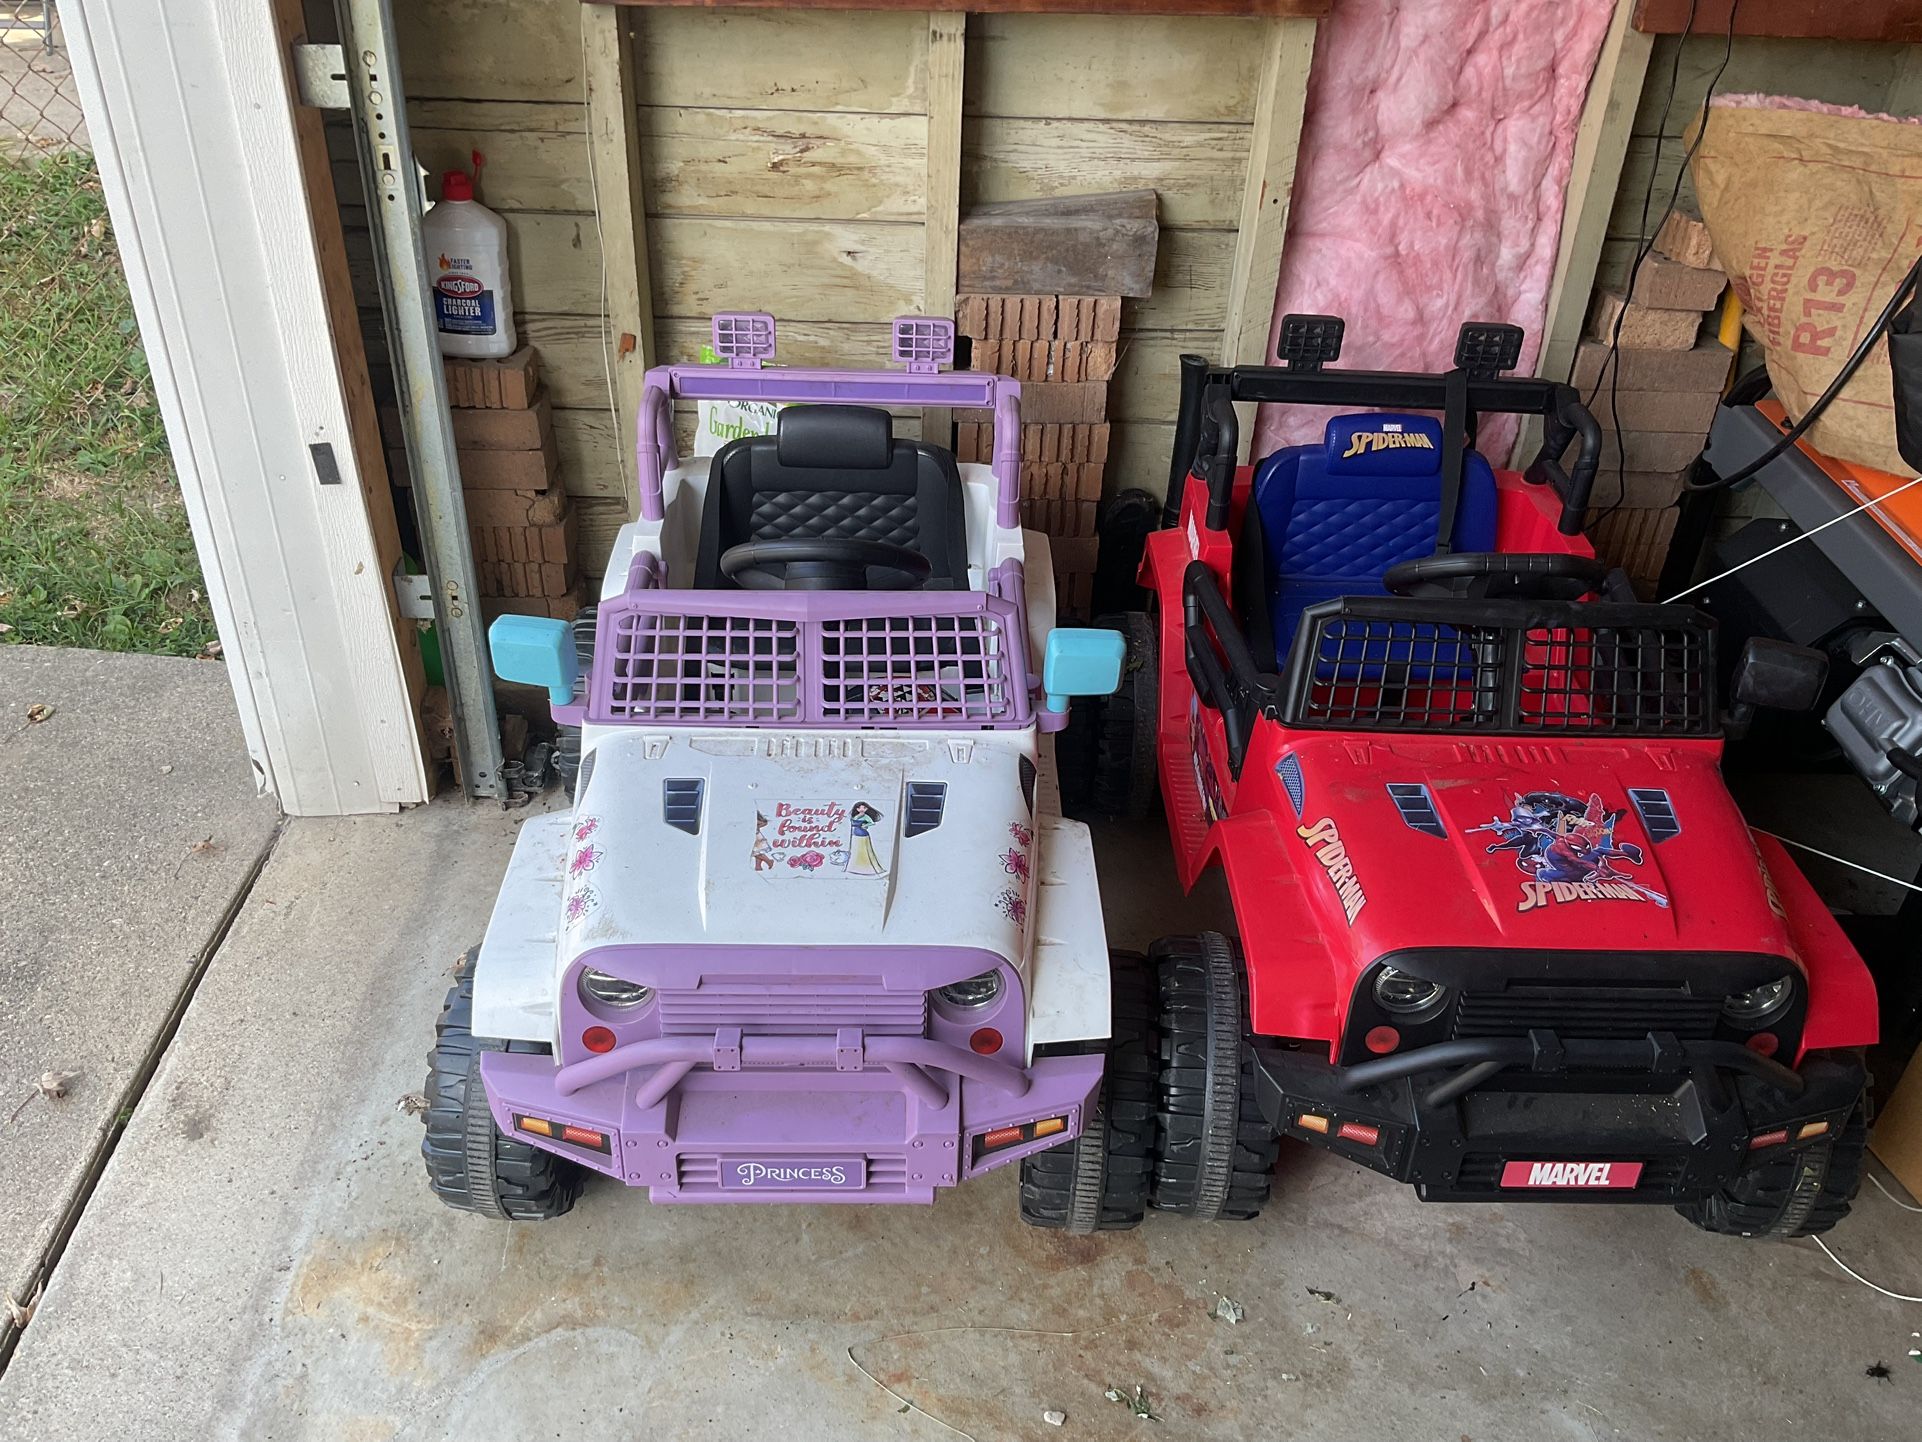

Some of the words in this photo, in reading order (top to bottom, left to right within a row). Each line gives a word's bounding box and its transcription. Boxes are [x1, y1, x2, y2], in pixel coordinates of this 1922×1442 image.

[440, 279, 479, 293] KINGSFORD
[1766, 233, 1808, 348] FIBERGLAS
[442, 298, 480, 307] CHARCOAL
[443, 306, 481, 316] LIGHTER
[1791, 266, 1857, 357] R13
[727, 400, 777, 419] ORGANI
[1343, 432, 1434, 458] SPIDER-MAN
[776, 801, 847, 823] Beauty
[778, 818, 837, 836] found
[772, 832, 843, 848] within
[1297, 816, 1368, 928] SPIDER-MAN
[1517, 881, 1647, 912] SPIDER-MAN
[1528, 1162, 1612, 1186] MARVEL
